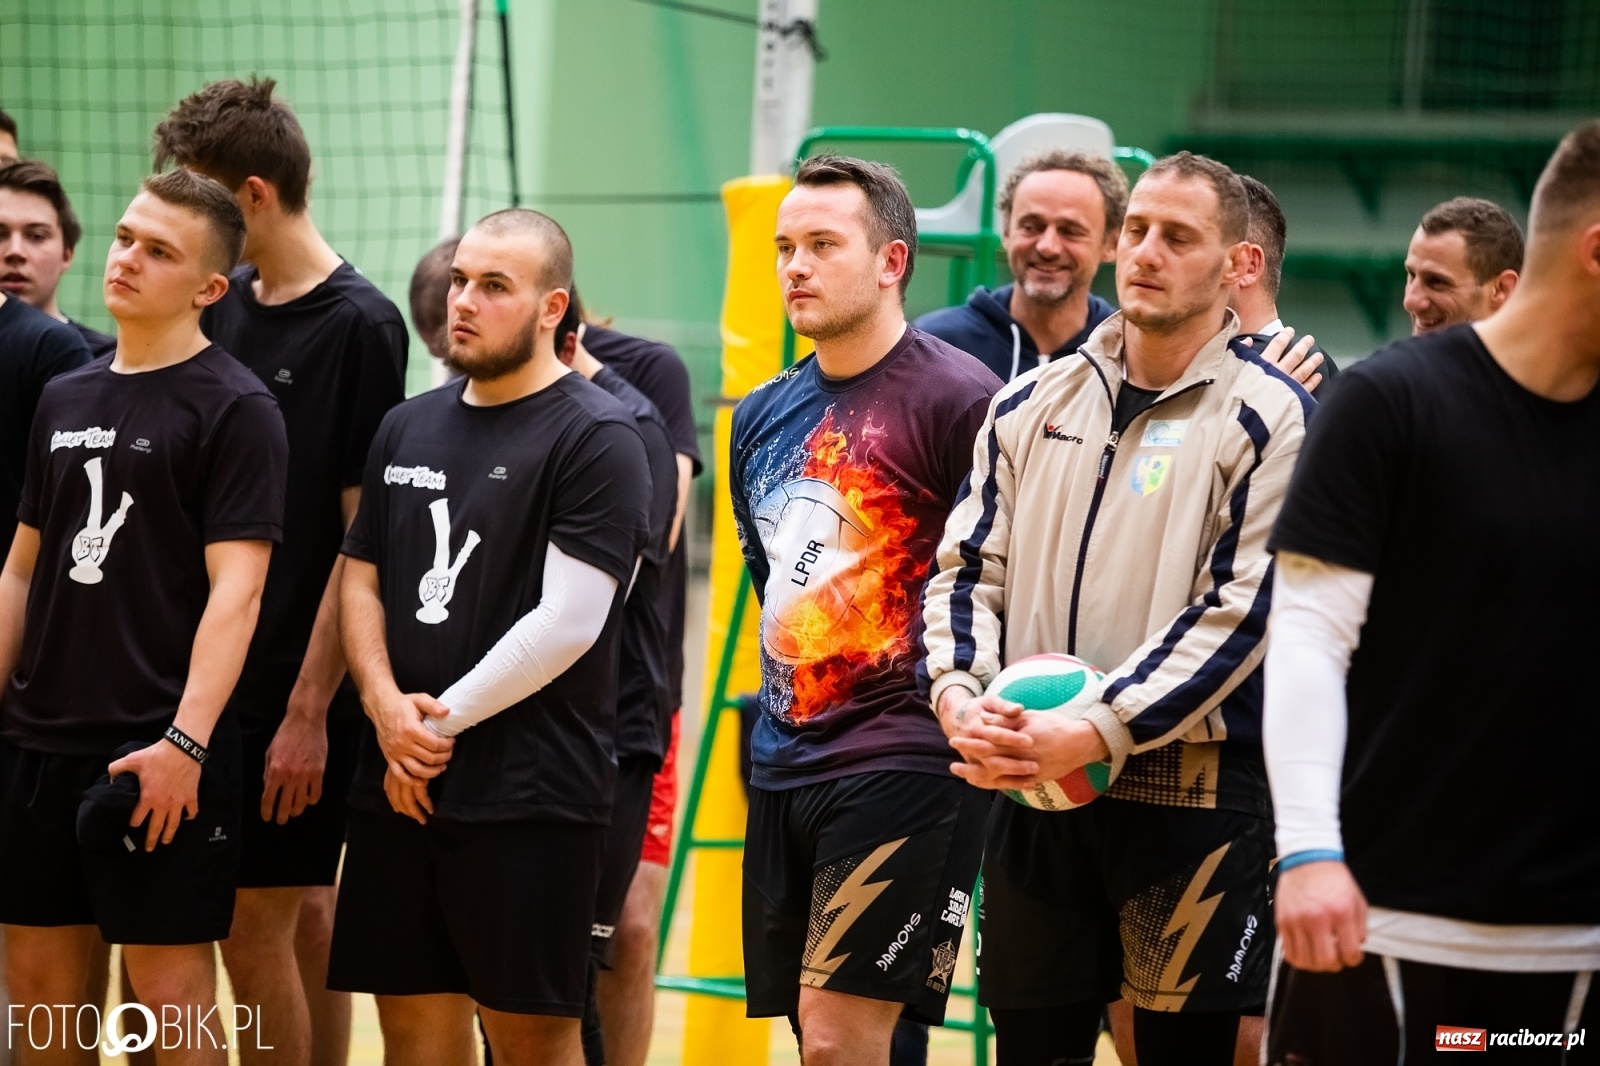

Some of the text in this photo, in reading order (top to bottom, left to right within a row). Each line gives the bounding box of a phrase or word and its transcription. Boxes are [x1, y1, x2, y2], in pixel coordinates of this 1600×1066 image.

[86, 428, 115, 447] TEAM
[76, 535, 104, 561] BT
[791, 539, 825, 587] LPDR
[165, 726, 193, 751] LANE
